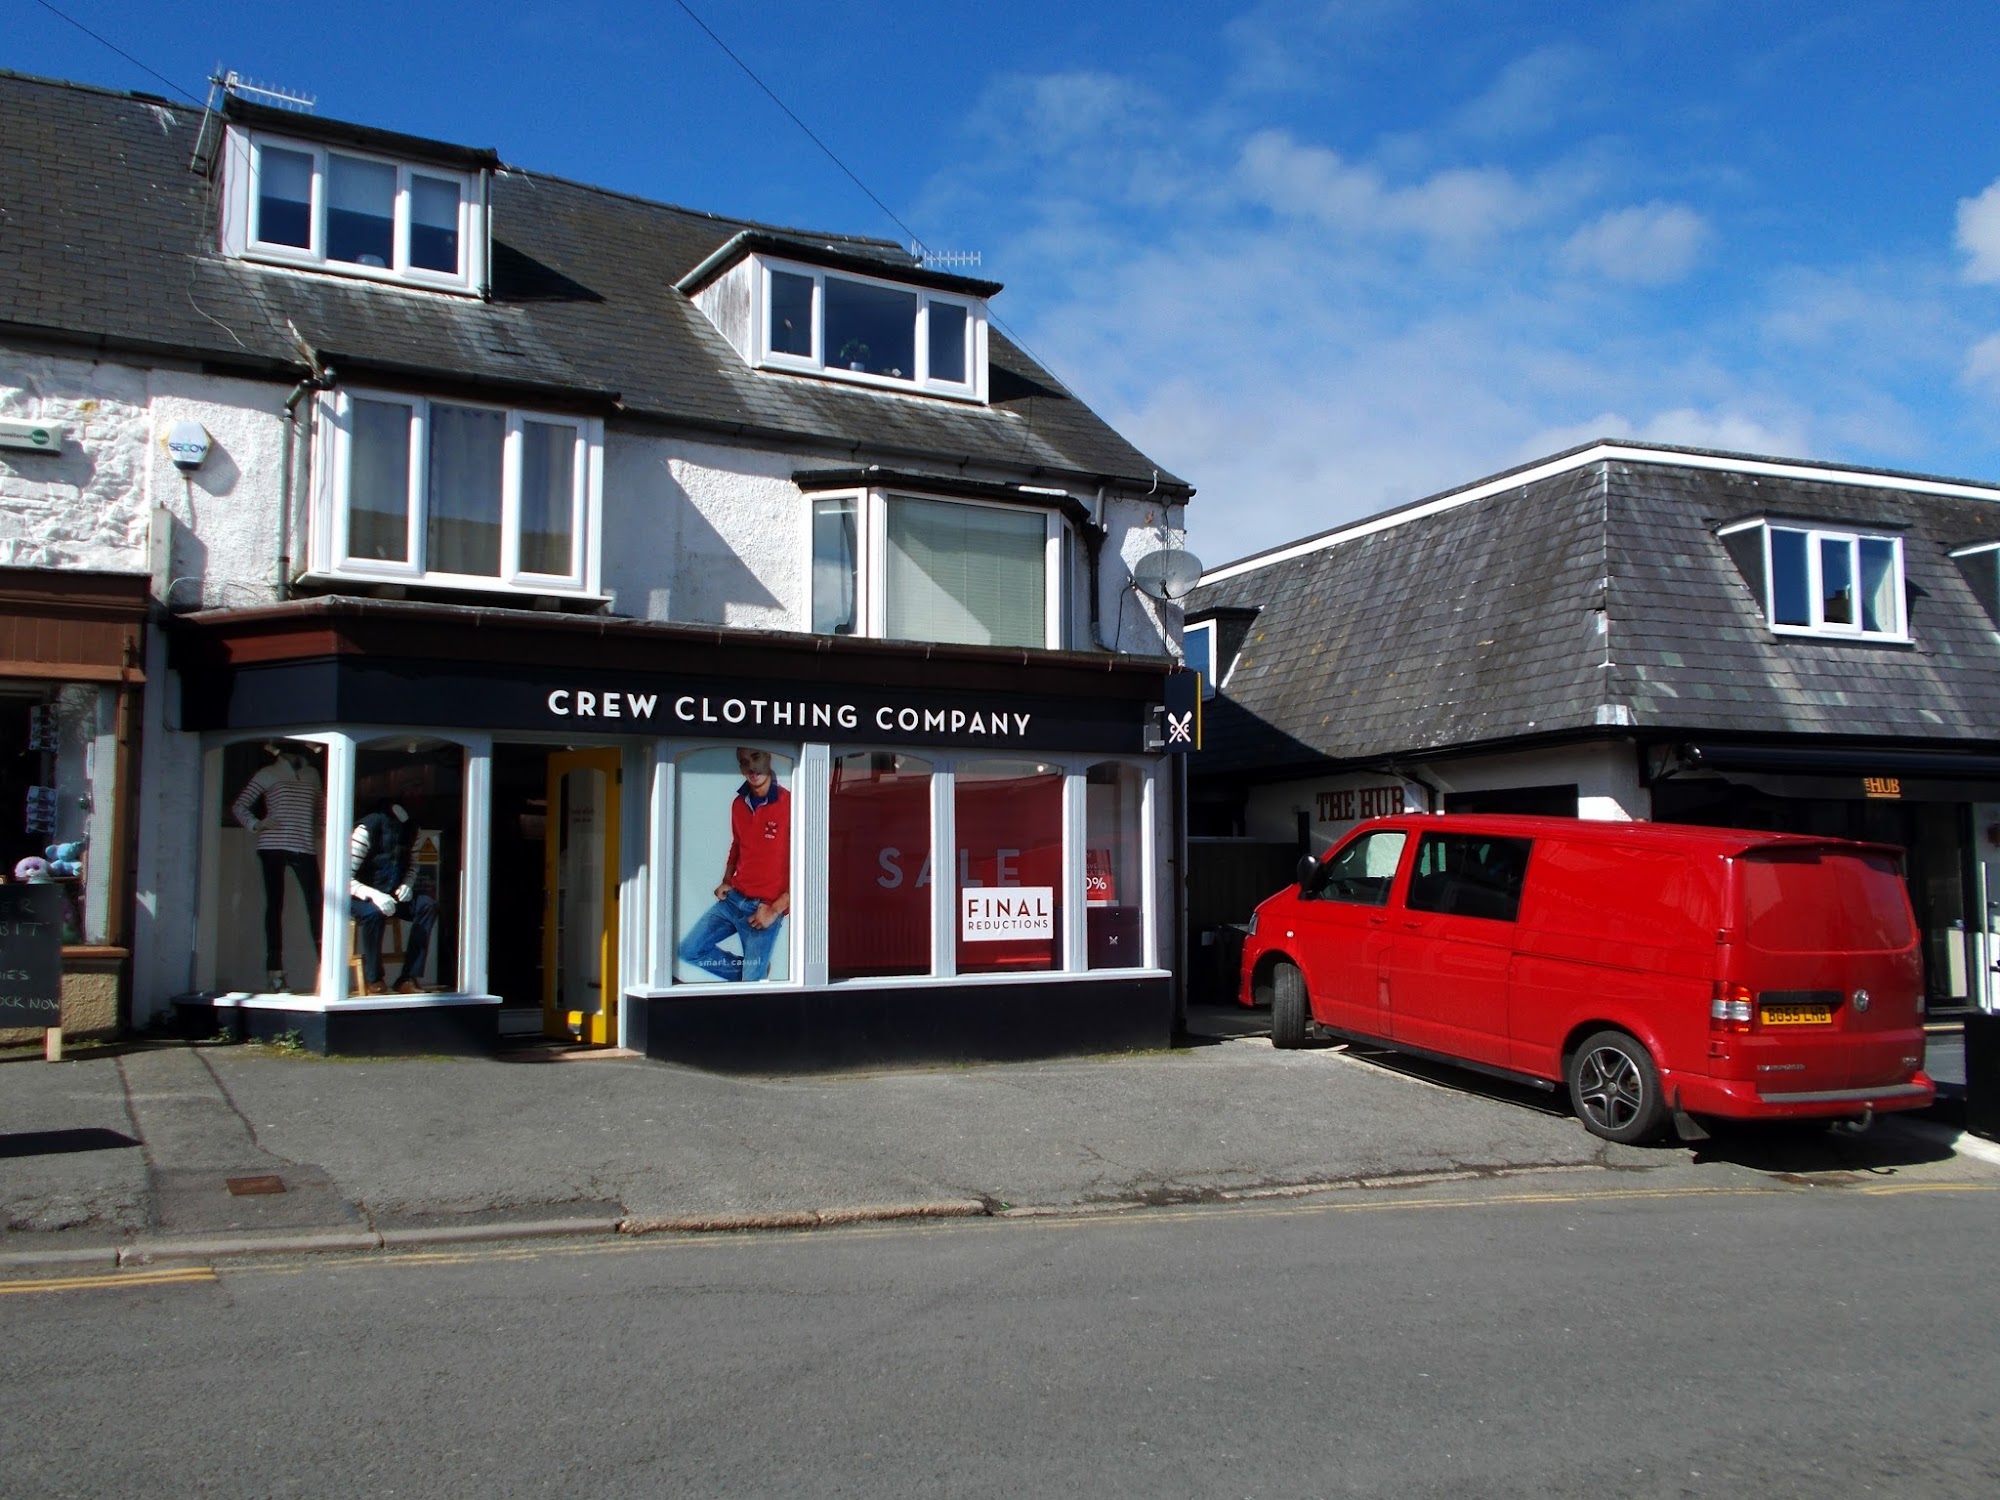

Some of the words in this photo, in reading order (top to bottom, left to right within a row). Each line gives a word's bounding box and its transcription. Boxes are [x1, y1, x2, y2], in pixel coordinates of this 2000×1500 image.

[548, 690, 658, 718] CREW
[675, 697, 857, 729] CLOTHING
[876, 707, 1031, 735] COMPANY
[1870, 778, 1901, 793] HUB
[1316, 790, 1355, 821] THE
[1358, 785, 1405, 818] HUB
[968, 898, 1048, 918] FINAL
[968, 919, 1048, 931] REDUCTIONS
